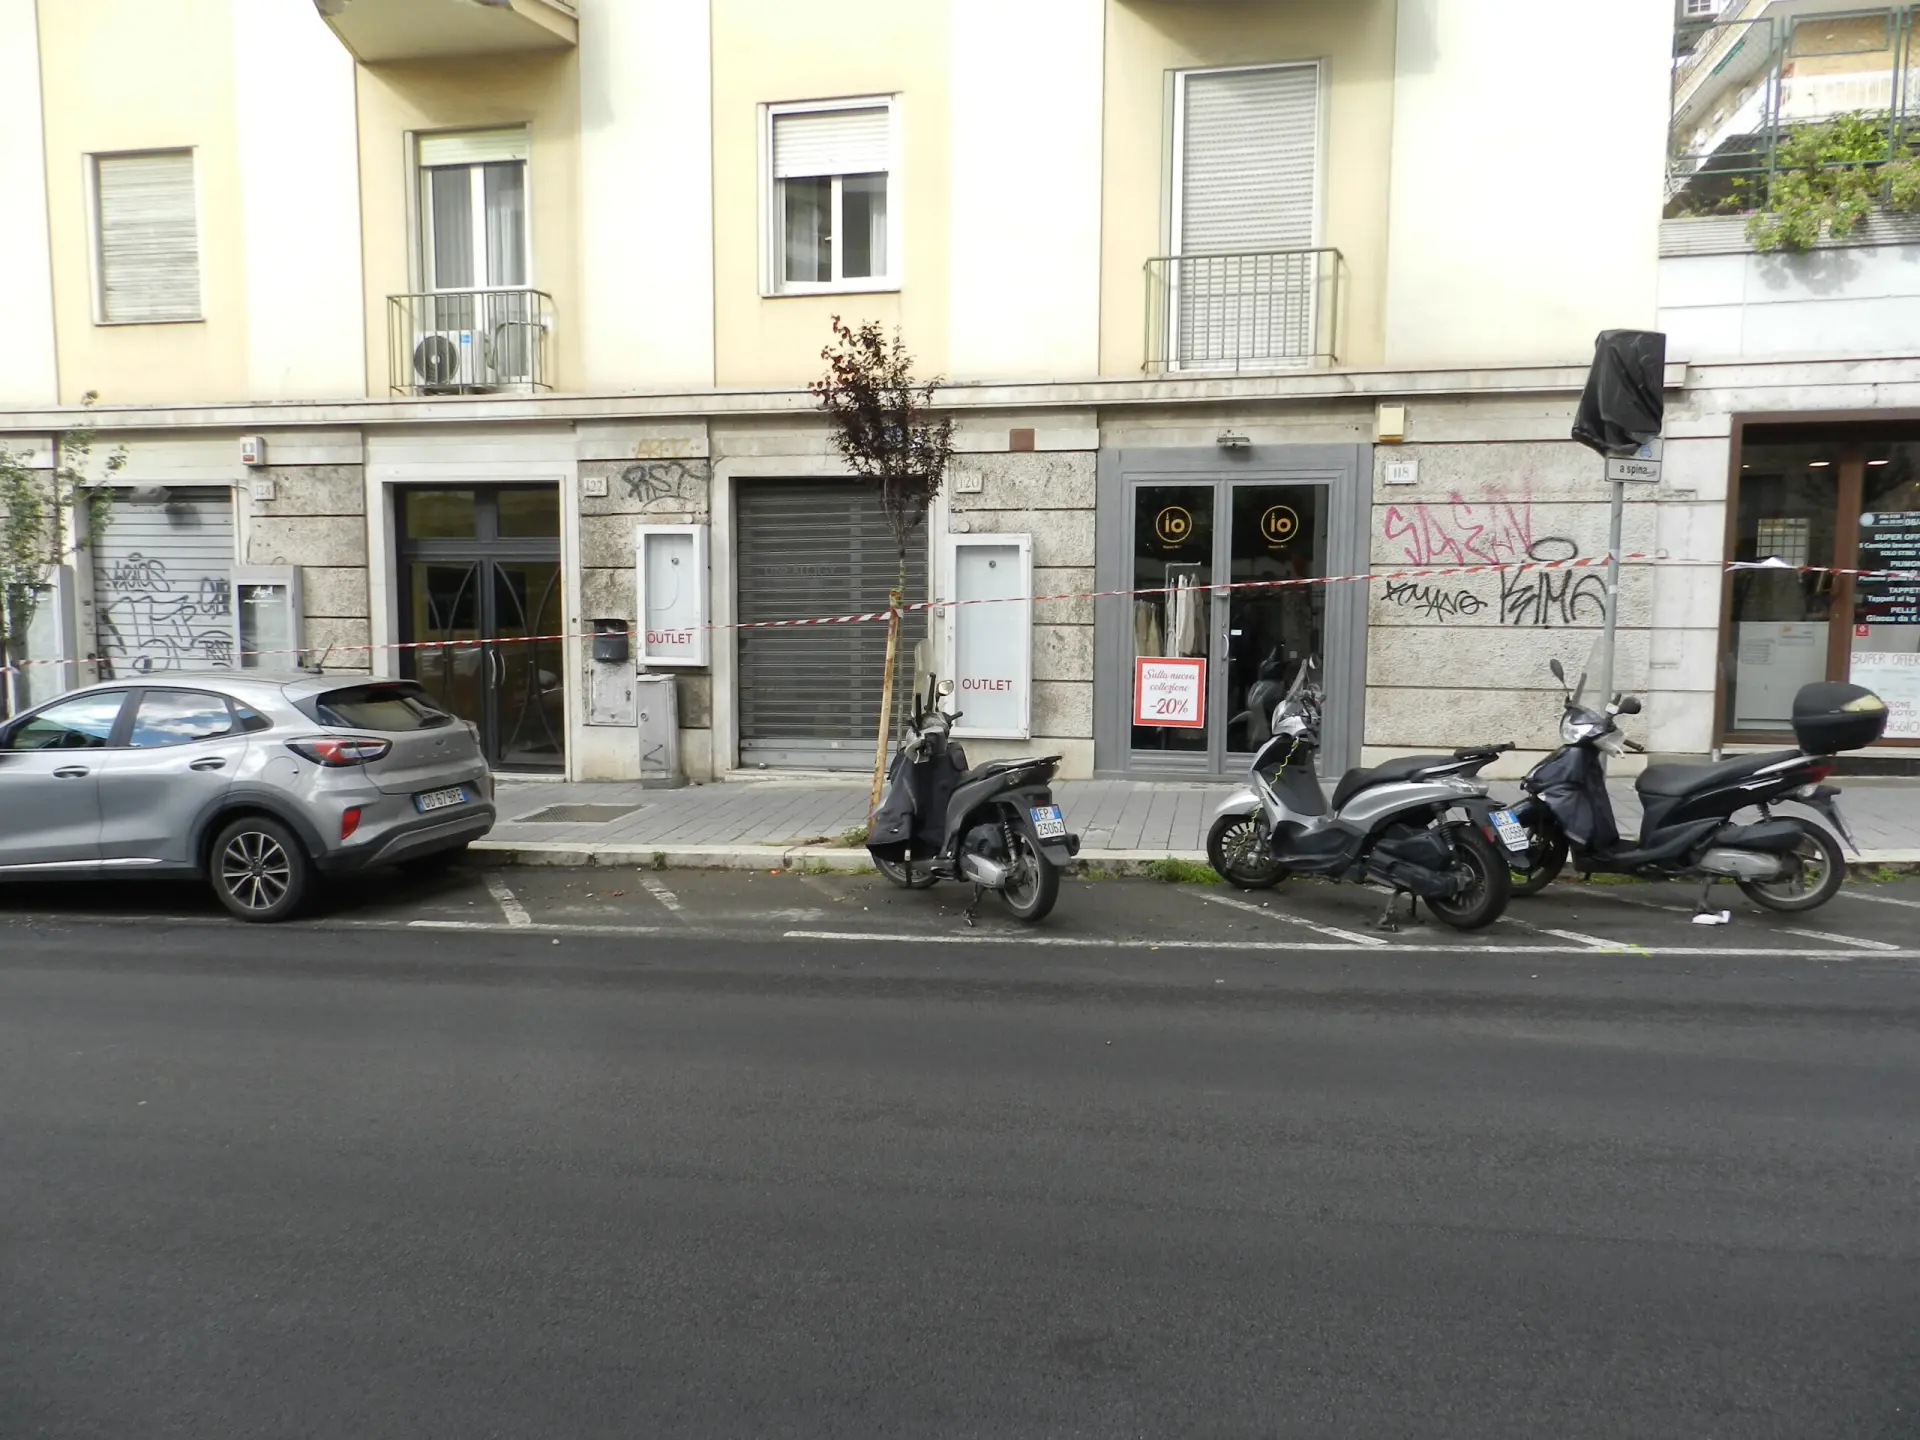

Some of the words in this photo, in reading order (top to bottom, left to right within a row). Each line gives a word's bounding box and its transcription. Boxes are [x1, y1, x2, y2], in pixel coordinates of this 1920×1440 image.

[1393, 467, 1410, 479] 118
[1619, 465, 1625, 473] a
[586, 480, 603, 492] 122
[960, 475, 980, 489] 120
[1874, 533, 1902, 541] SUPER
[1906, 595, 1916, 604] kg
[1890, 606, 1917, 614] PELLE
[1897, 614, 1909, 622] da
[647, 632, 693, 644] OUTLET
[1851, 653, 1886, 665] SUPER
[1144, 668, 1168, 680] Sulla
[1170, 672, 1195, 680] nuova
[962, 678, 1013, 691] OUTLET
[1149, 682, 1188, 694] collezione
[1149, 697, 1189, 715] -20%
[1037, 808, 1049, 820] EP
[1037, 821, 1065, 836] 23062
